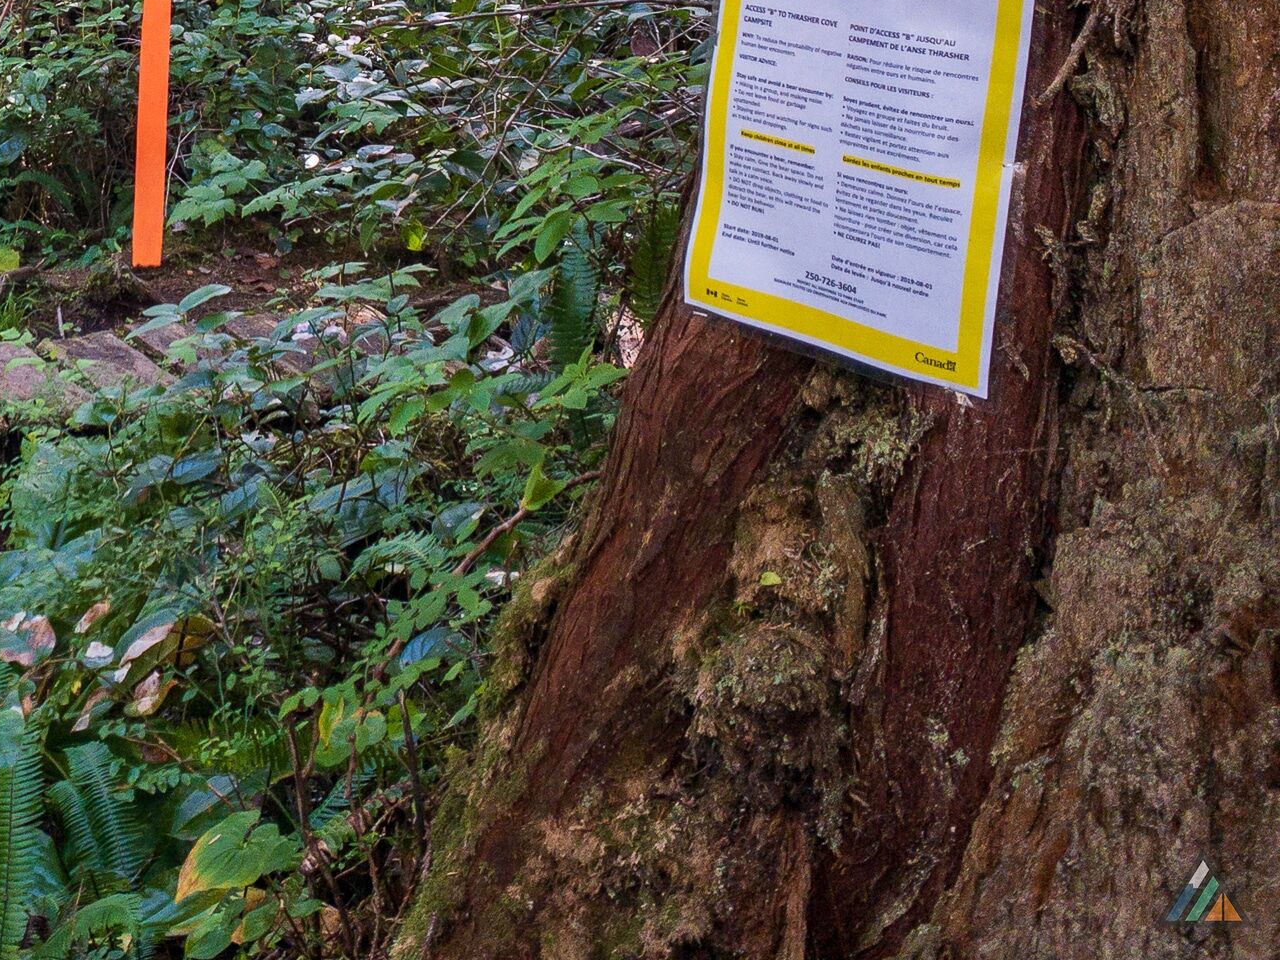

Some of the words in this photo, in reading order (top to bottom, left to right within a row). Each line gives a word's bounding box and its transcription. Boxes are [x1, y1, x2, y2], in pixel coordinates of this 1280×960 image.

[744, 15, 772, 26] CAMPSITE
[745, 4, 765, 13] ACCESS
[788, 12, 819, 23] THRASHER
[820, 18, 837, 27] COVE
[850, 24, 868, 32] POINT
[848, 35, 888, 48] CAMPEMENT
[928, 49, 969, 60] THRASHER
[805, 271, 856, 294] 250-726-3604
